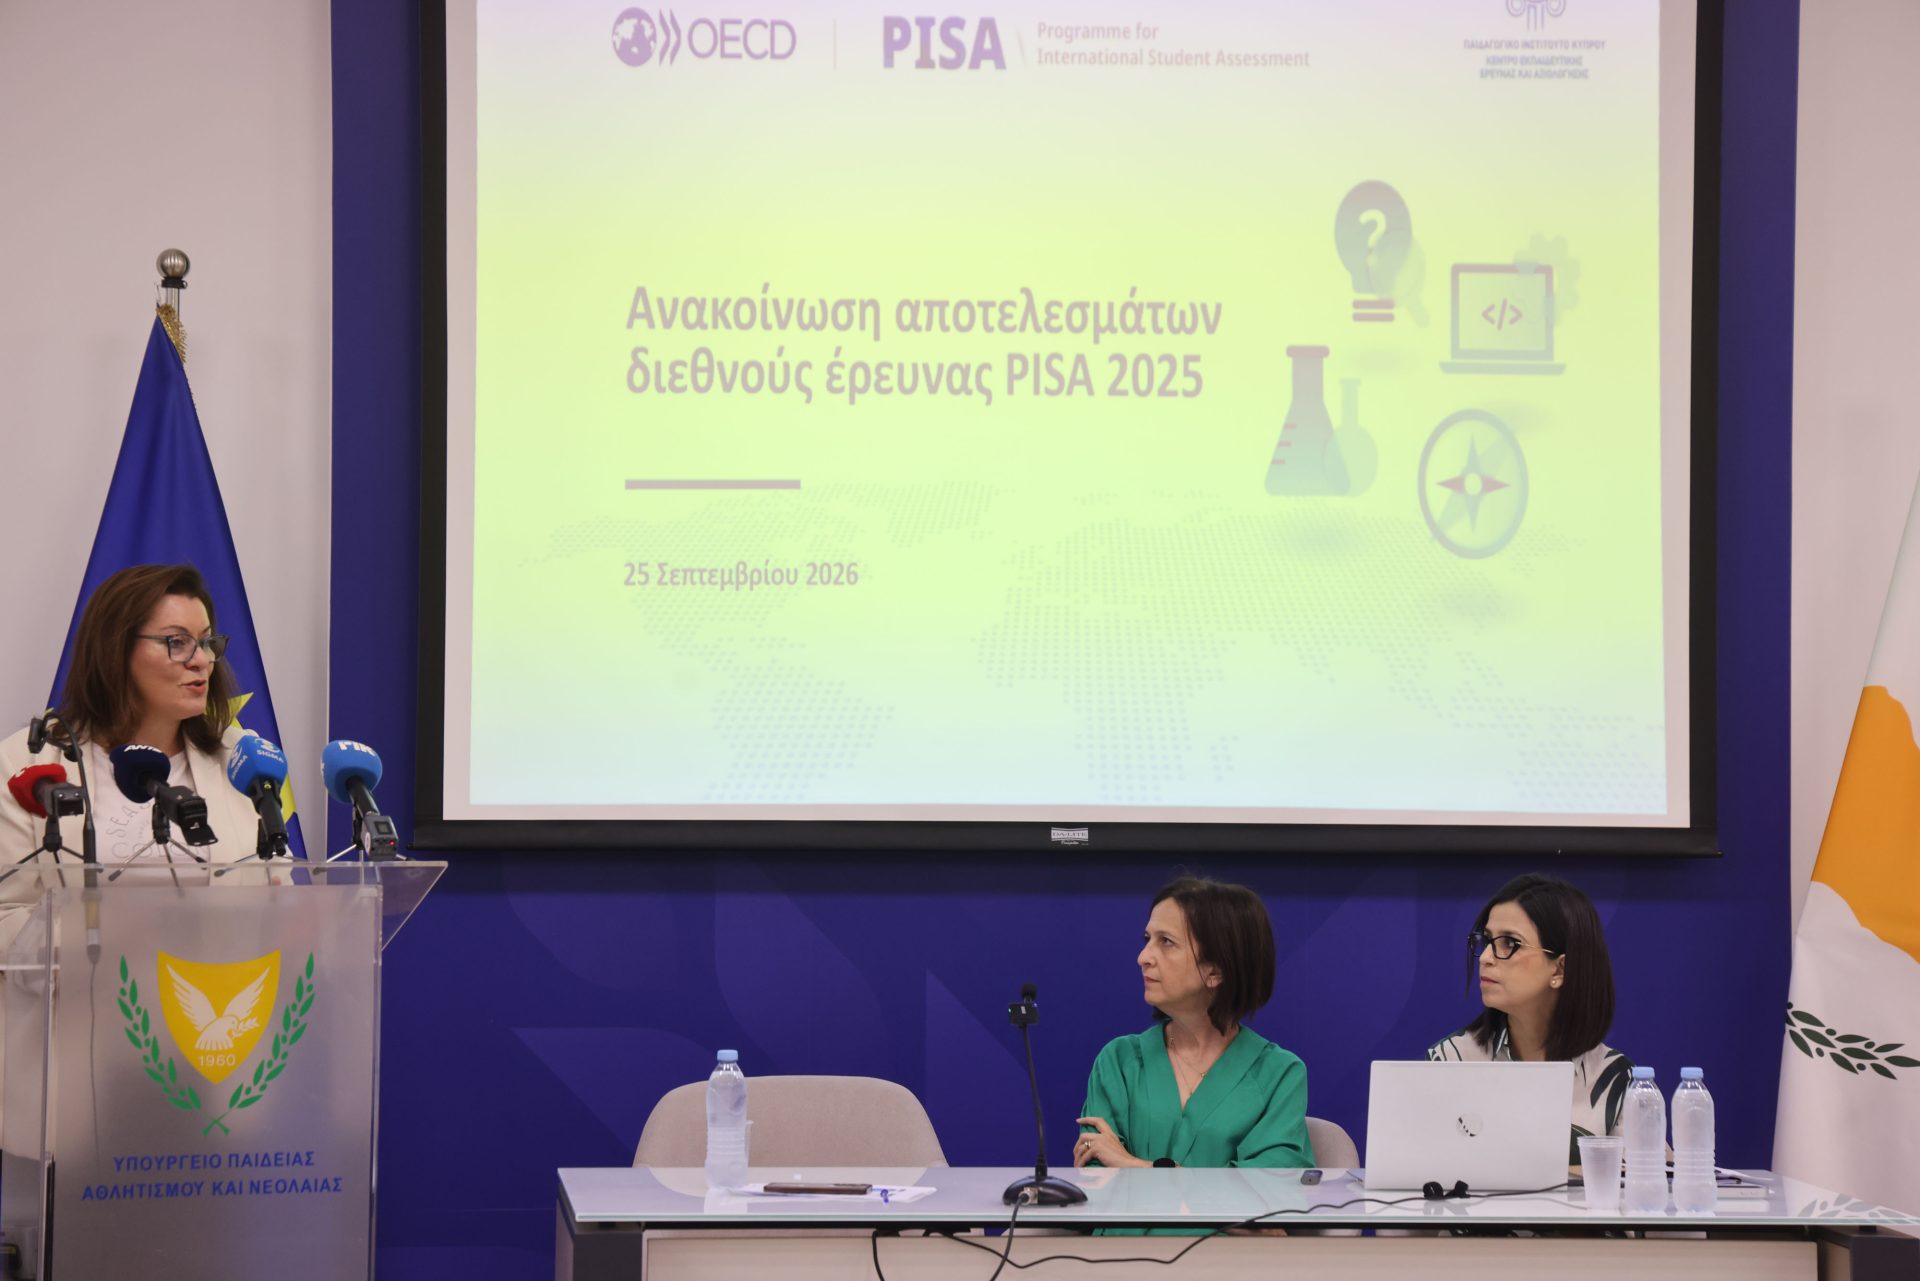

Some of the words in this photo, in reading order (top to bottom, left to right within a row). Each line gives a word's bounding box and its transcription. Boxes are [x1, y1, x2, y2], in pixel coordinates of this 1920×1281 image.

[687, 17, 797, 61] OECD
[883, 15, 1007, 70] PISA
[1037, 22, 1131, 44] Programme
[1136, 21, 1160, 40] for
[1571, 39, 1607, 50] ΚΥΠΡΟΥ
[1037, 47, 1143, 66] International
[1148, 48, 1211, 67] Student
[1215, 49, 1311, 68] Assessment
[625, 282, 881, 342] Ανακοίνωση
[895, 286, 1222, 345] αποτελεσμάτων
[626, 345, 813, 404] διεθνούς
[825, 345, 993, 406] έρευνας
[1006, 352, 1095, 397] PISA
[1107, 353, 1204, 399] 2025
[623, 561, 650, 586] 25
[656, 559, 799, 592] Σεπτεμβρίου
[805, 561, 859, 586] 2026
[256, 749, 285, 764] SIGMA
[199, 1054, 236, 1068] 1960
[112, 1153, 222, 1172] ΥΠΟΥΡΓΕΙΟ
[228, 1151, 315, 1169] ΠΑΙΔΕΙΑΣ
[81, 1181, 205, 1201] ΑΘΛΗΤΙΣΜΟΥ
[212, 1180, 243, 1197] ΚΑΙ
[249, 1177, 343, 1196] ΝΕΟΛΑΙΑΣ
